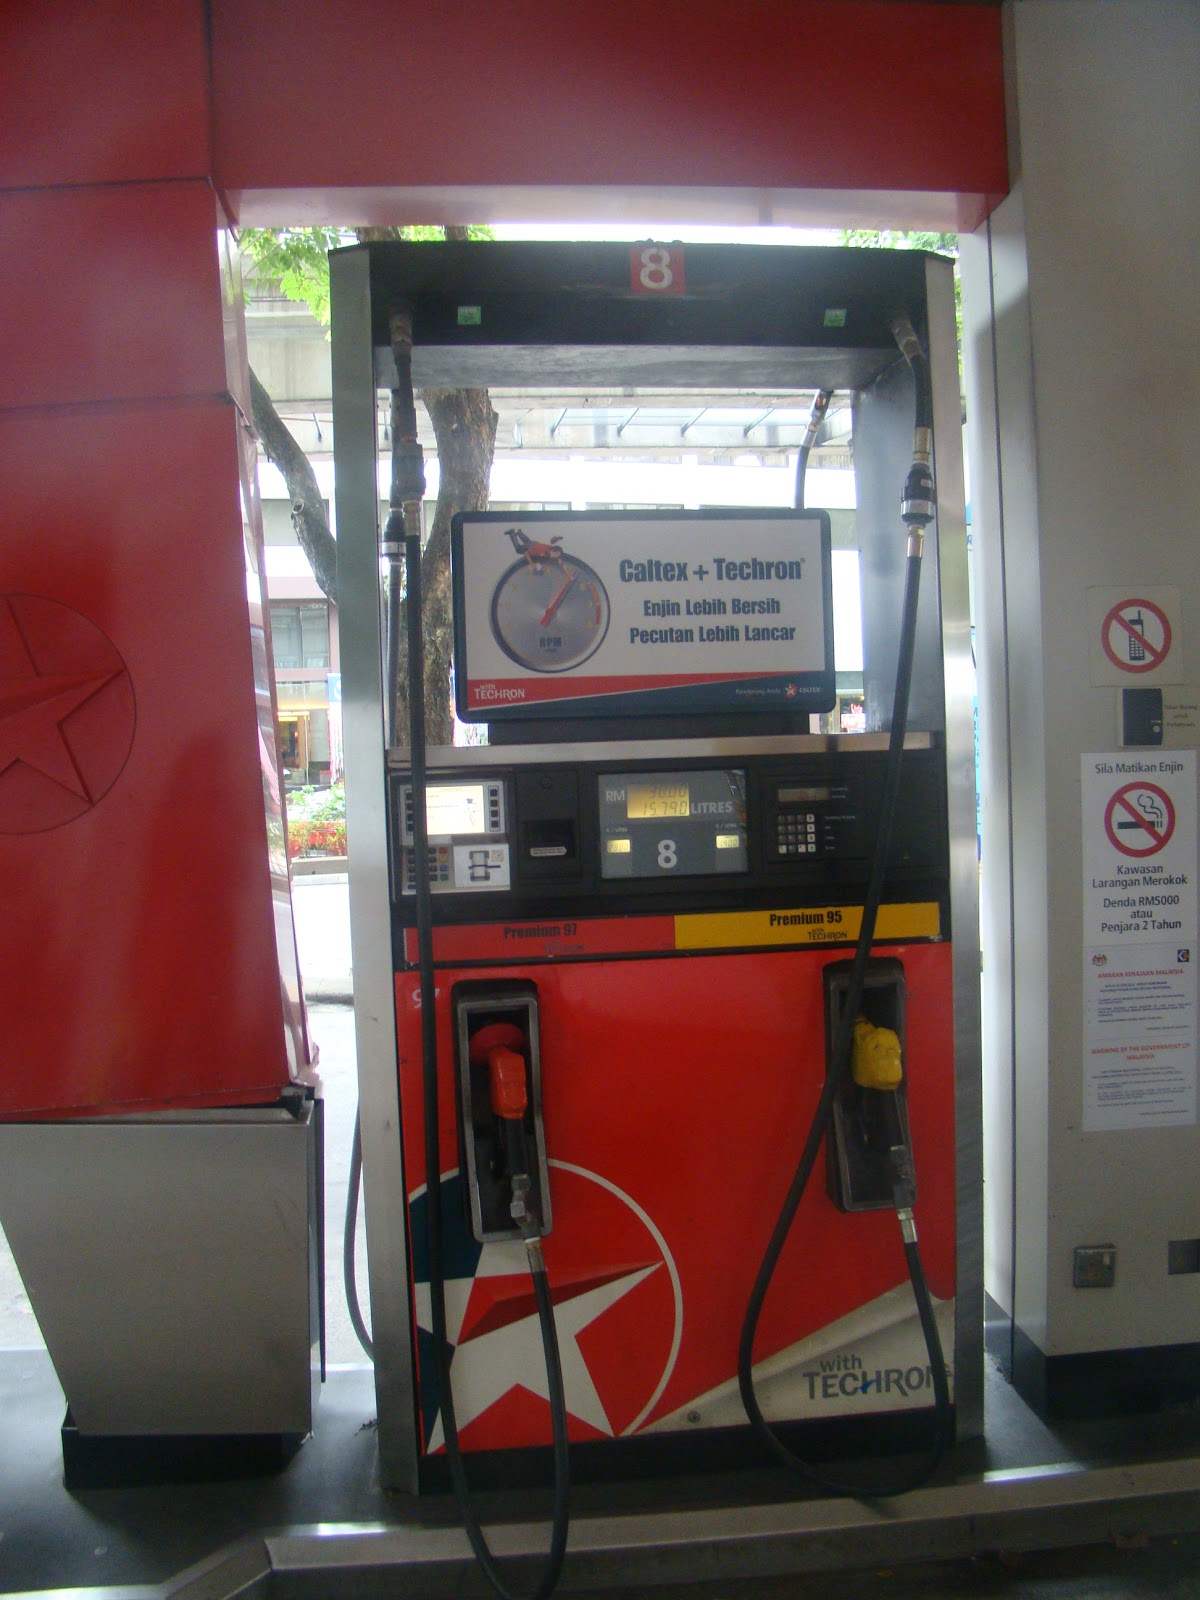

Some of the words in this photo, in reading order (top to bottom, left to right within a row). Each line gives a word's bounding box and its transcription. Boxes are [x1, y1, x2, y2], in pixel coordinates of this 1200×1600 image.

[640, 248, 672, 289] 8
[619, 559, 688, 582] Caltex
[693, 565, 709, 581] +
[643, 600, 681, 617] Enjin
[685, 599, 727, 615] Lebih
[731, 598, 781, 614] Bersih
[629, 627, 694, 644] Pecutan
[699, 626, 740, 642] Lebih
[744, 625, 796, 641] Lancar
[474, 688, 525, 700] TECHRON
[1095, 763, 1113, 774] Sila
[1115, 762, 1157, 773] Matikan
[1159, 761, 1184, 774] Enjin
[605, 789, 625, 801] RM
[690, 801, 733, 814] LITRES
[657, 839, 678, 869] 8
[1117, 865, 1163, 875] Kawasan
[1092, 877, 1140, 890] Larangan
[1142, 874, 1187, 886] Merokok
[1103, 896, 1136, 908] Denda
[1138, 895, 1180, 906] RM5000
[770, 912, 824, 926] Premium
[827, 910, 842, 923] 95
[1130, 909, 1152, 918] atau
[504, 926, 560, 940] Premium
[1101, 921, 1140, 934] Penjara
[1142, 921, 1148, 931] 2
[1151, 919, 1181, 930] Tahun
[807, 931, 848, 941] TECHRON
[819, 1354, 862, 1373] with
